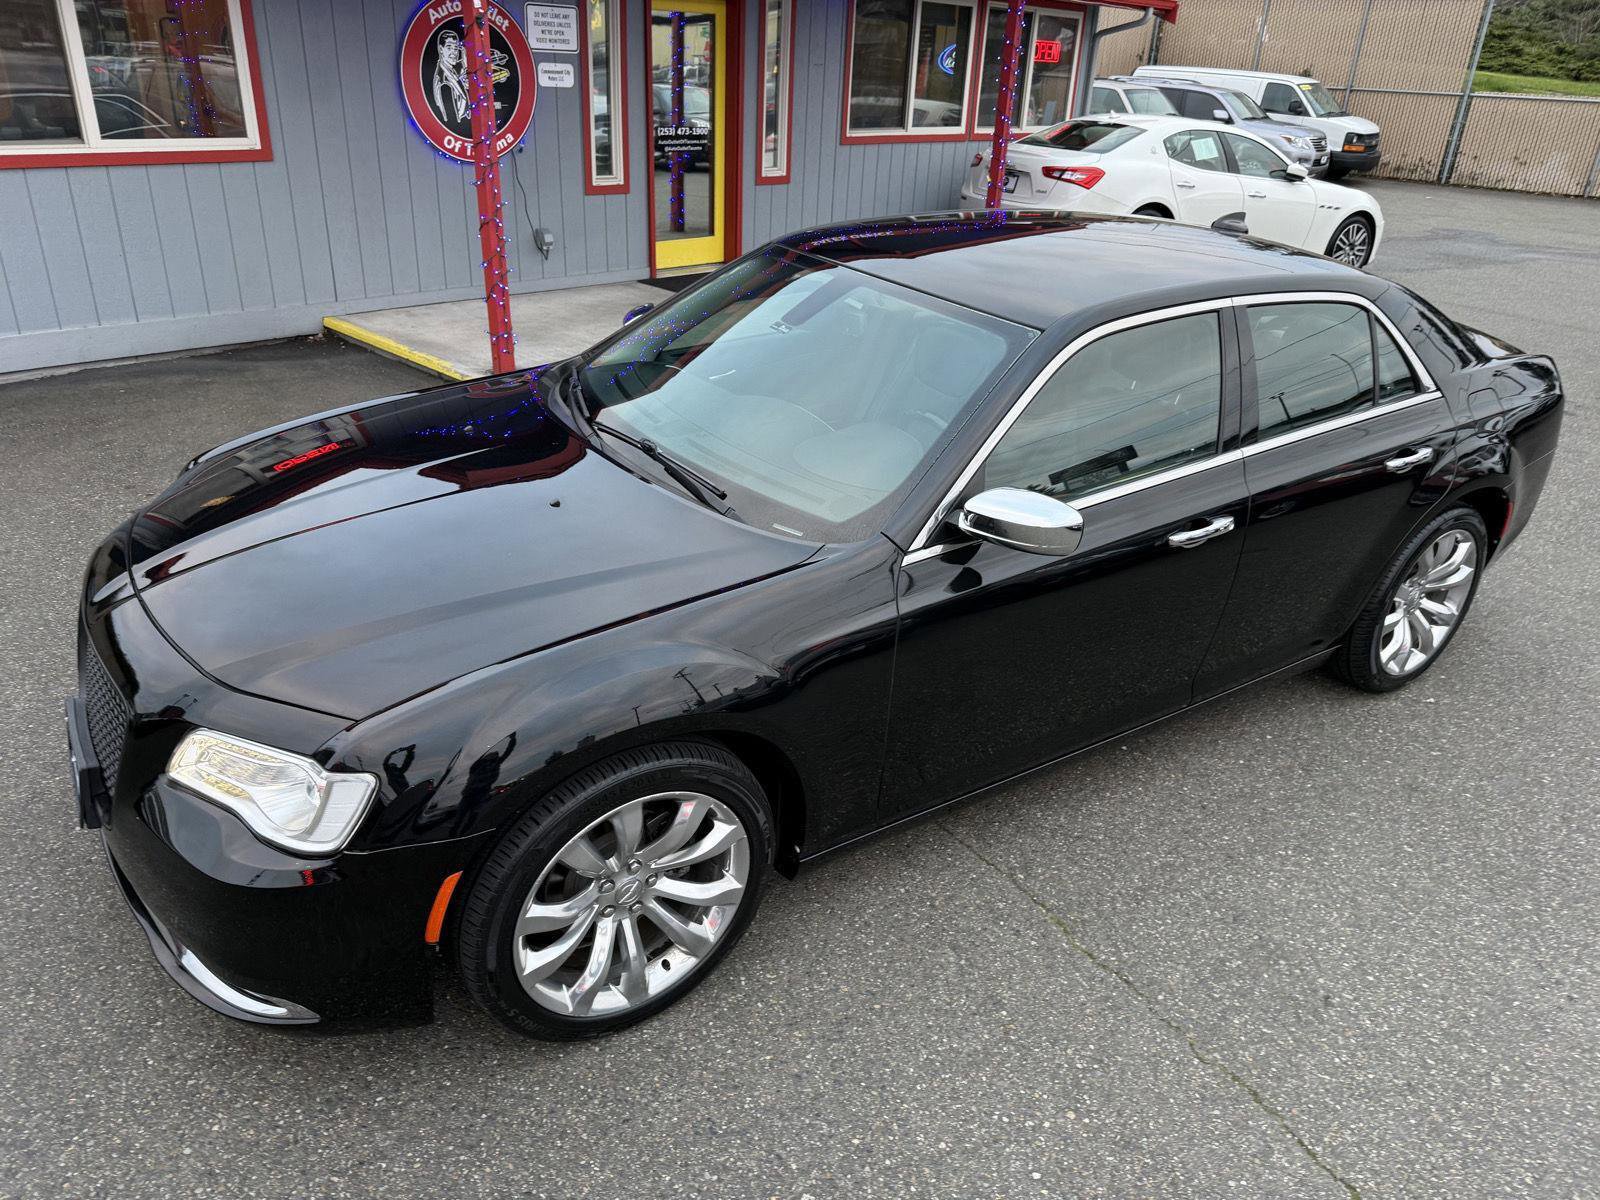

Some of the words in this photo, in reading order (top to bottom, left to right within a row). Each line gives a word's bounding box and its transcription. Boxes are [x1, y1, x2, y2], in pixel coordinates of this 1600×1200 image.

[428, 1, 462, 24] Auto
[533, 20, 556, 28] DELIVERIES
[657, 127, 676, 136] (253)
[677, 127, 708, 135] 473-1900
[443, 136, 462, 153] Of
[464, 133, 515, 156] Tma
